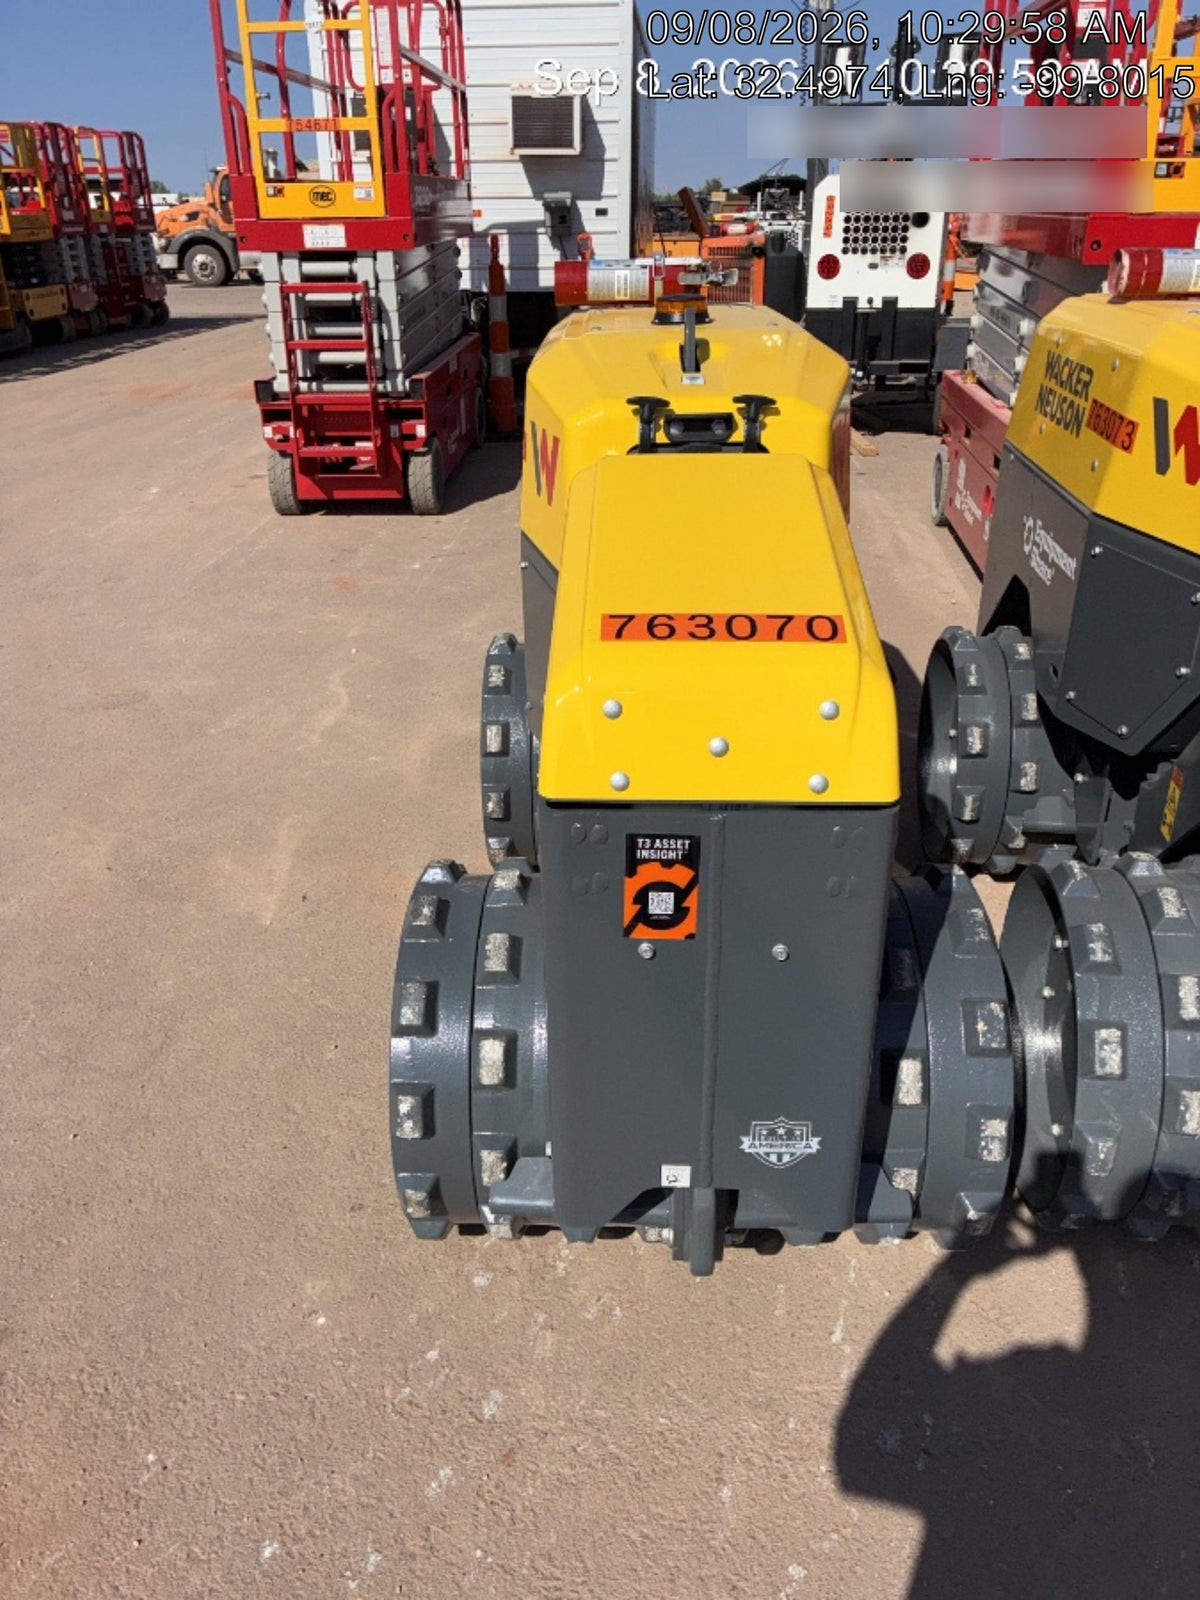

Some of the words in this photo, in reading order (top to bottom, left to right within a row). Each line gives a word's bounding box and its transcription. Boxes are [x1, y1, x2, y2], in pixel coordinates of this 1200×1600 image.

[1044, 349, 1095, 402] WACKER
[1035, 383, 1086, 439] NEUSON
[608, 613, 840, 642] 763070
[636, 838, 652, 850] T3
[654, 838, 691, 851] ASSET
[636, 849, 684, 860] INSIGHT
